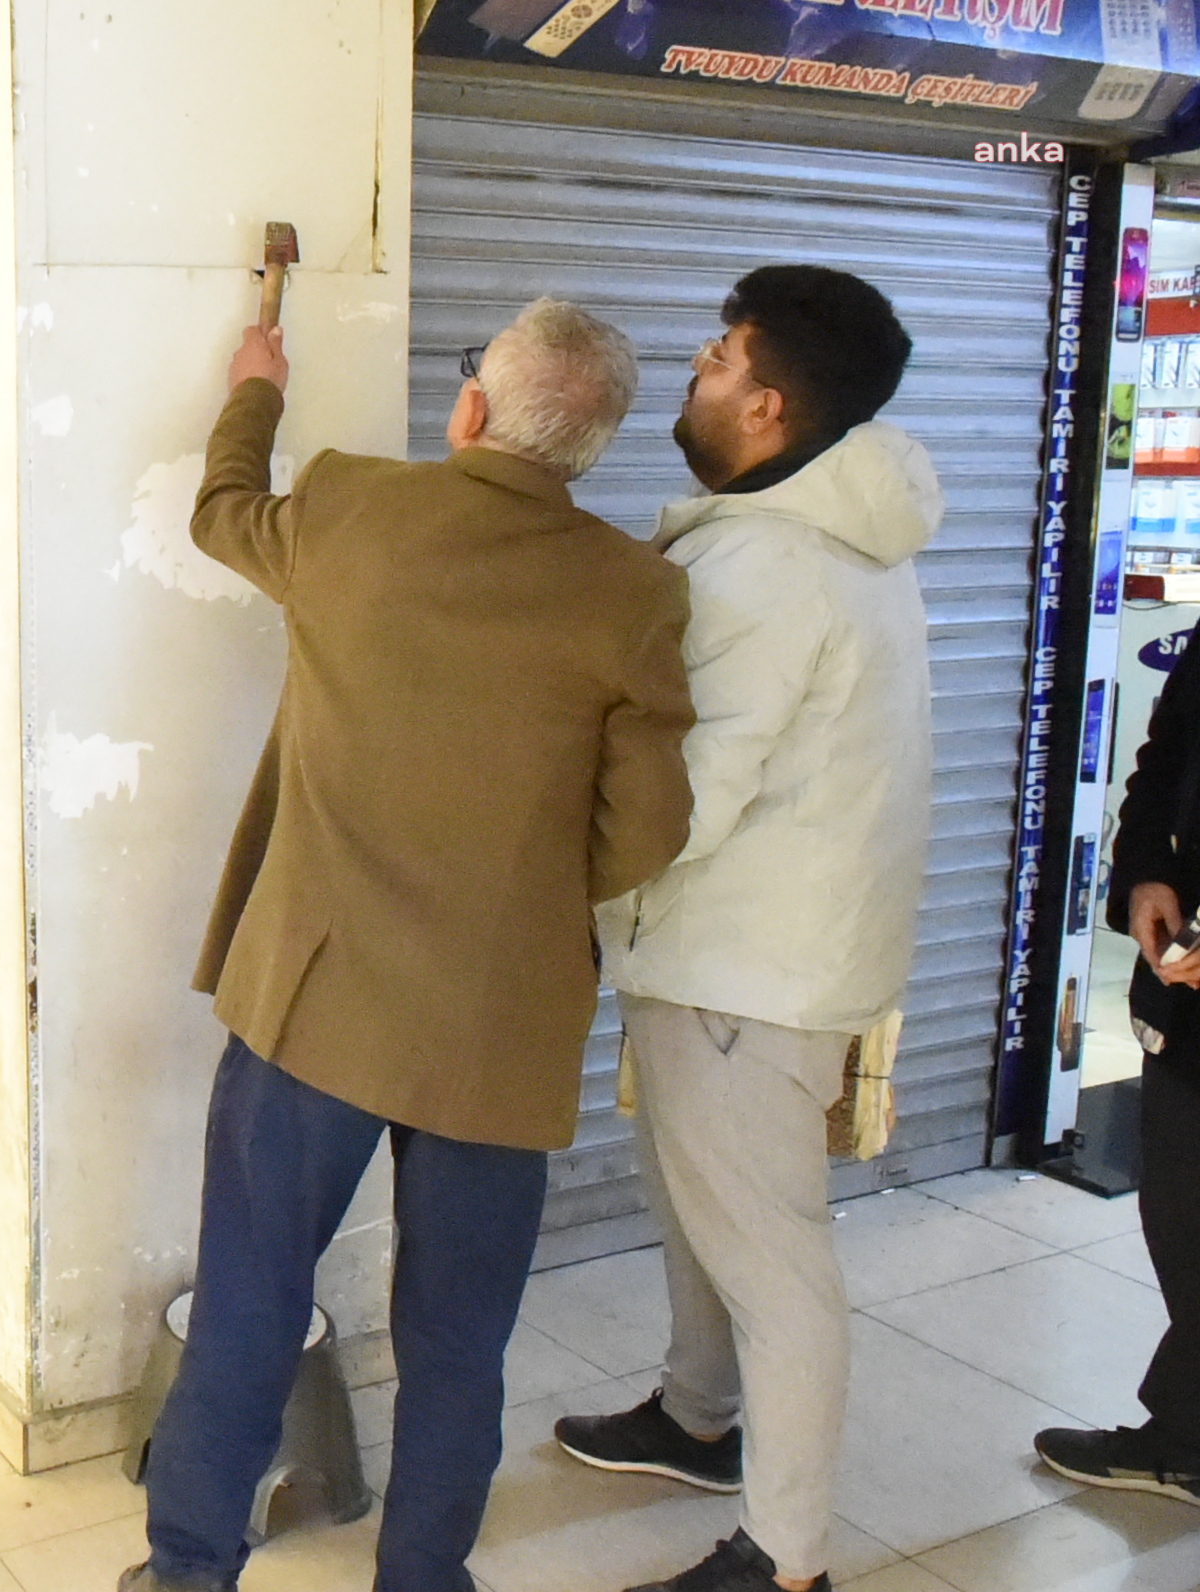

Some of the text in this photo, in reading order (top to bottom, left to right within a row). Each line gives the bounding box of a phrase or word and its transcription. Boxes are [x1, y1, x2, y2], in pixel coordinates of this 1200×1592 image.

[776, 57, 911, 97] KUMANDA
[904, 73, 1039, 110] ÇEŞİTLERİ
[1067, 175, 1092, 226] CEP
[1058, 236, 1088, 373] TELEFONU
[1041, 500, 1067, 610] YAPILIR
[1033, 646, 1057, 696] CEP
[1024, 704, 1053, 830] TELEFONU
[1005, 948, 1032, 1051] YAPILIR
